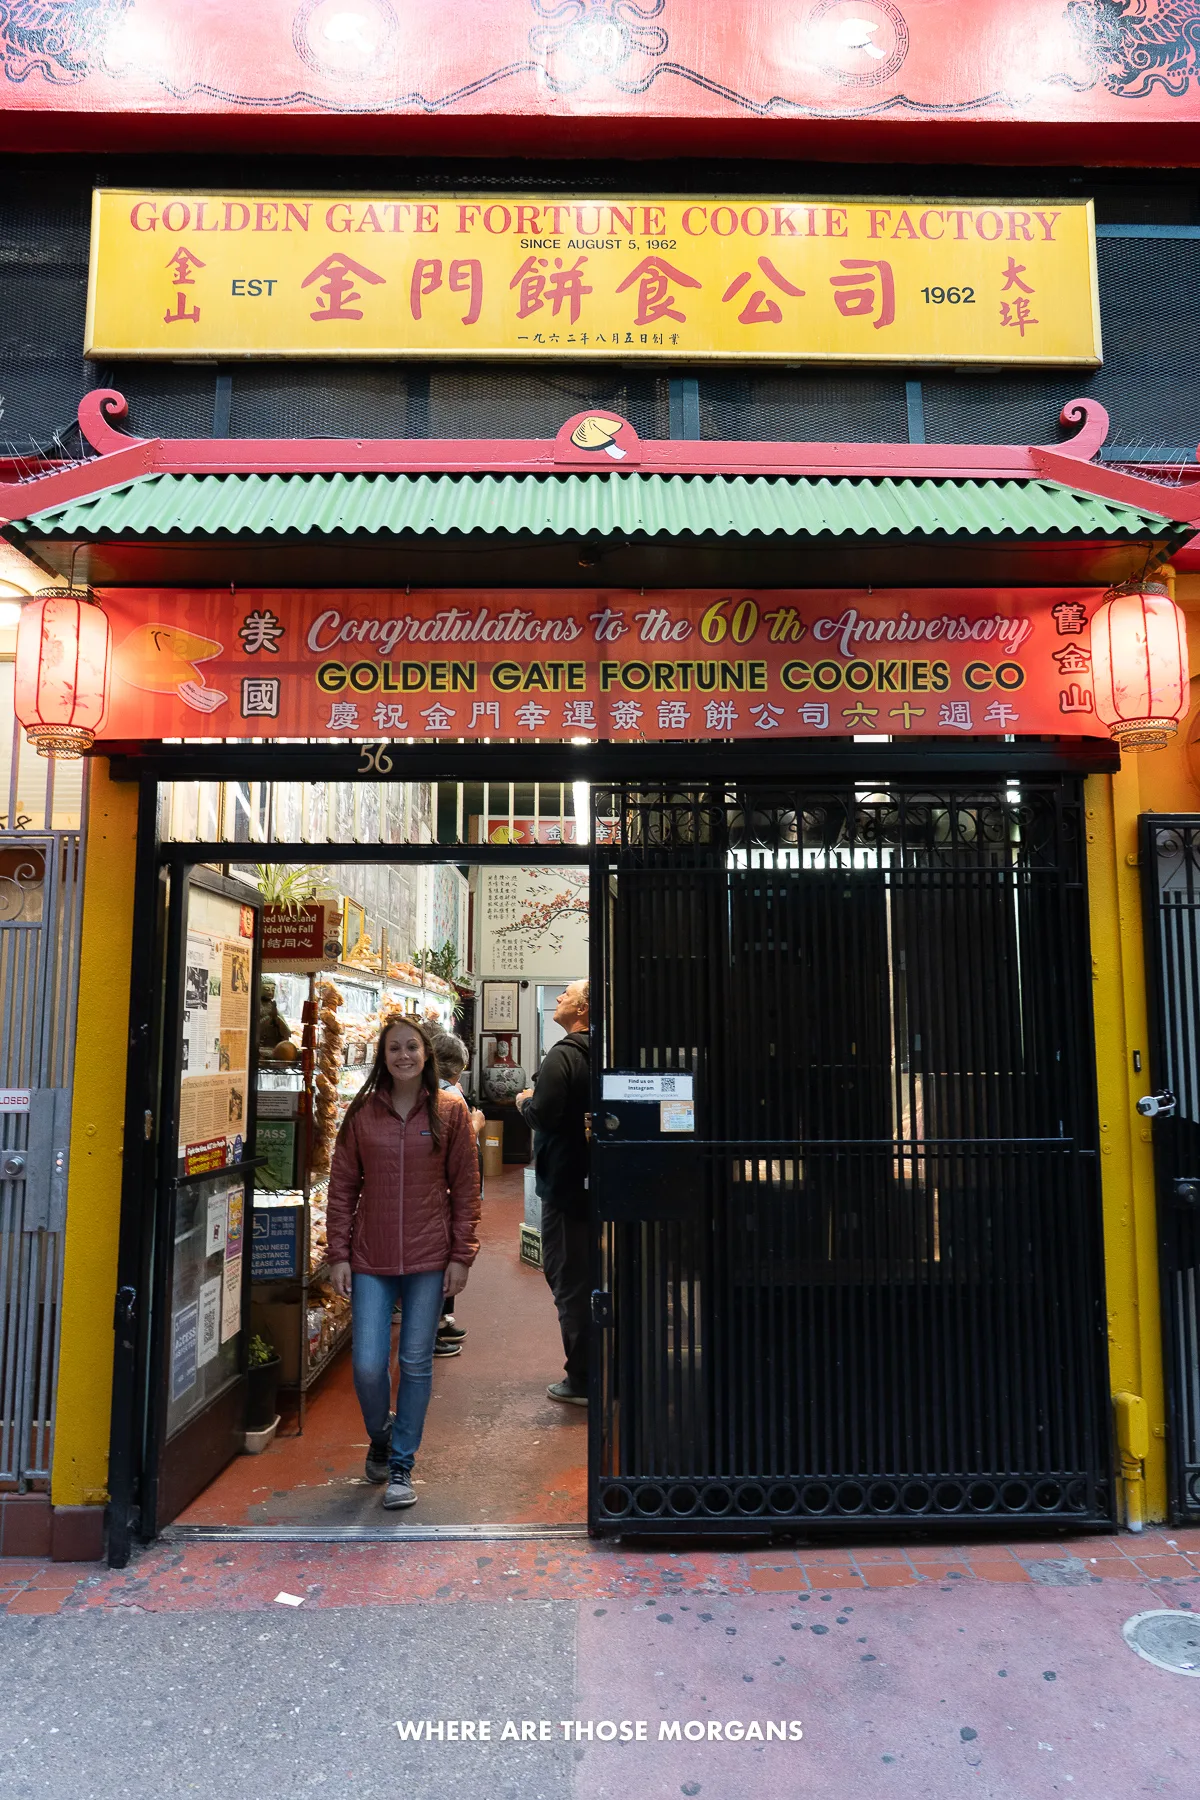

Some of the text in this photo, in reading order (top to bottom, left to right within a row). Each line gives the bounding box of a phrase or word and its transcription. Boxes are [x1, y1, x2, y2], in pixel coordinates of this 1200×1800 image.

[130, 202, 1061, 242] GOLDEN GATE FORTUNE COOKIE FACTORY
[520, 239, 677, 251] SINCE AUGUST 5, 1962
[164, 246, 206, 324] 金山
[231, 279, 278, 297] EST
[301, 253, 895, 330] 金門餅食公司
[920, 286, 976, 304] 1962
[999, 256, 1039, 337] 大埠
[307, 607, 583, 655] Congratulations
[589, 608, 628, 642] to
[634, 608, 692, 642] the
[813, 608, 1033, 657] Anniversary
[239, 609, 285, 719] 美國
[1052, 602, 1093, 715] 舊金山
[317, 660, 1027, 692] GOLDEN GATE FORTUNE COOKIES CO
[358, 743, 393, 774] 56
[263, 914, 276, 923] ted
[278, 914, 291, 923] We
[264, 925, 314, 934] ided We Fall
[262, 938, 313, 949] 結同心
[257, 1129, 287, 1139] PASS
[252, 1252, 291, 1260] SSISTANCE,
[270, 1243, 290, 1251] NEED
[252, 1260, 274, 1268] LEASE
